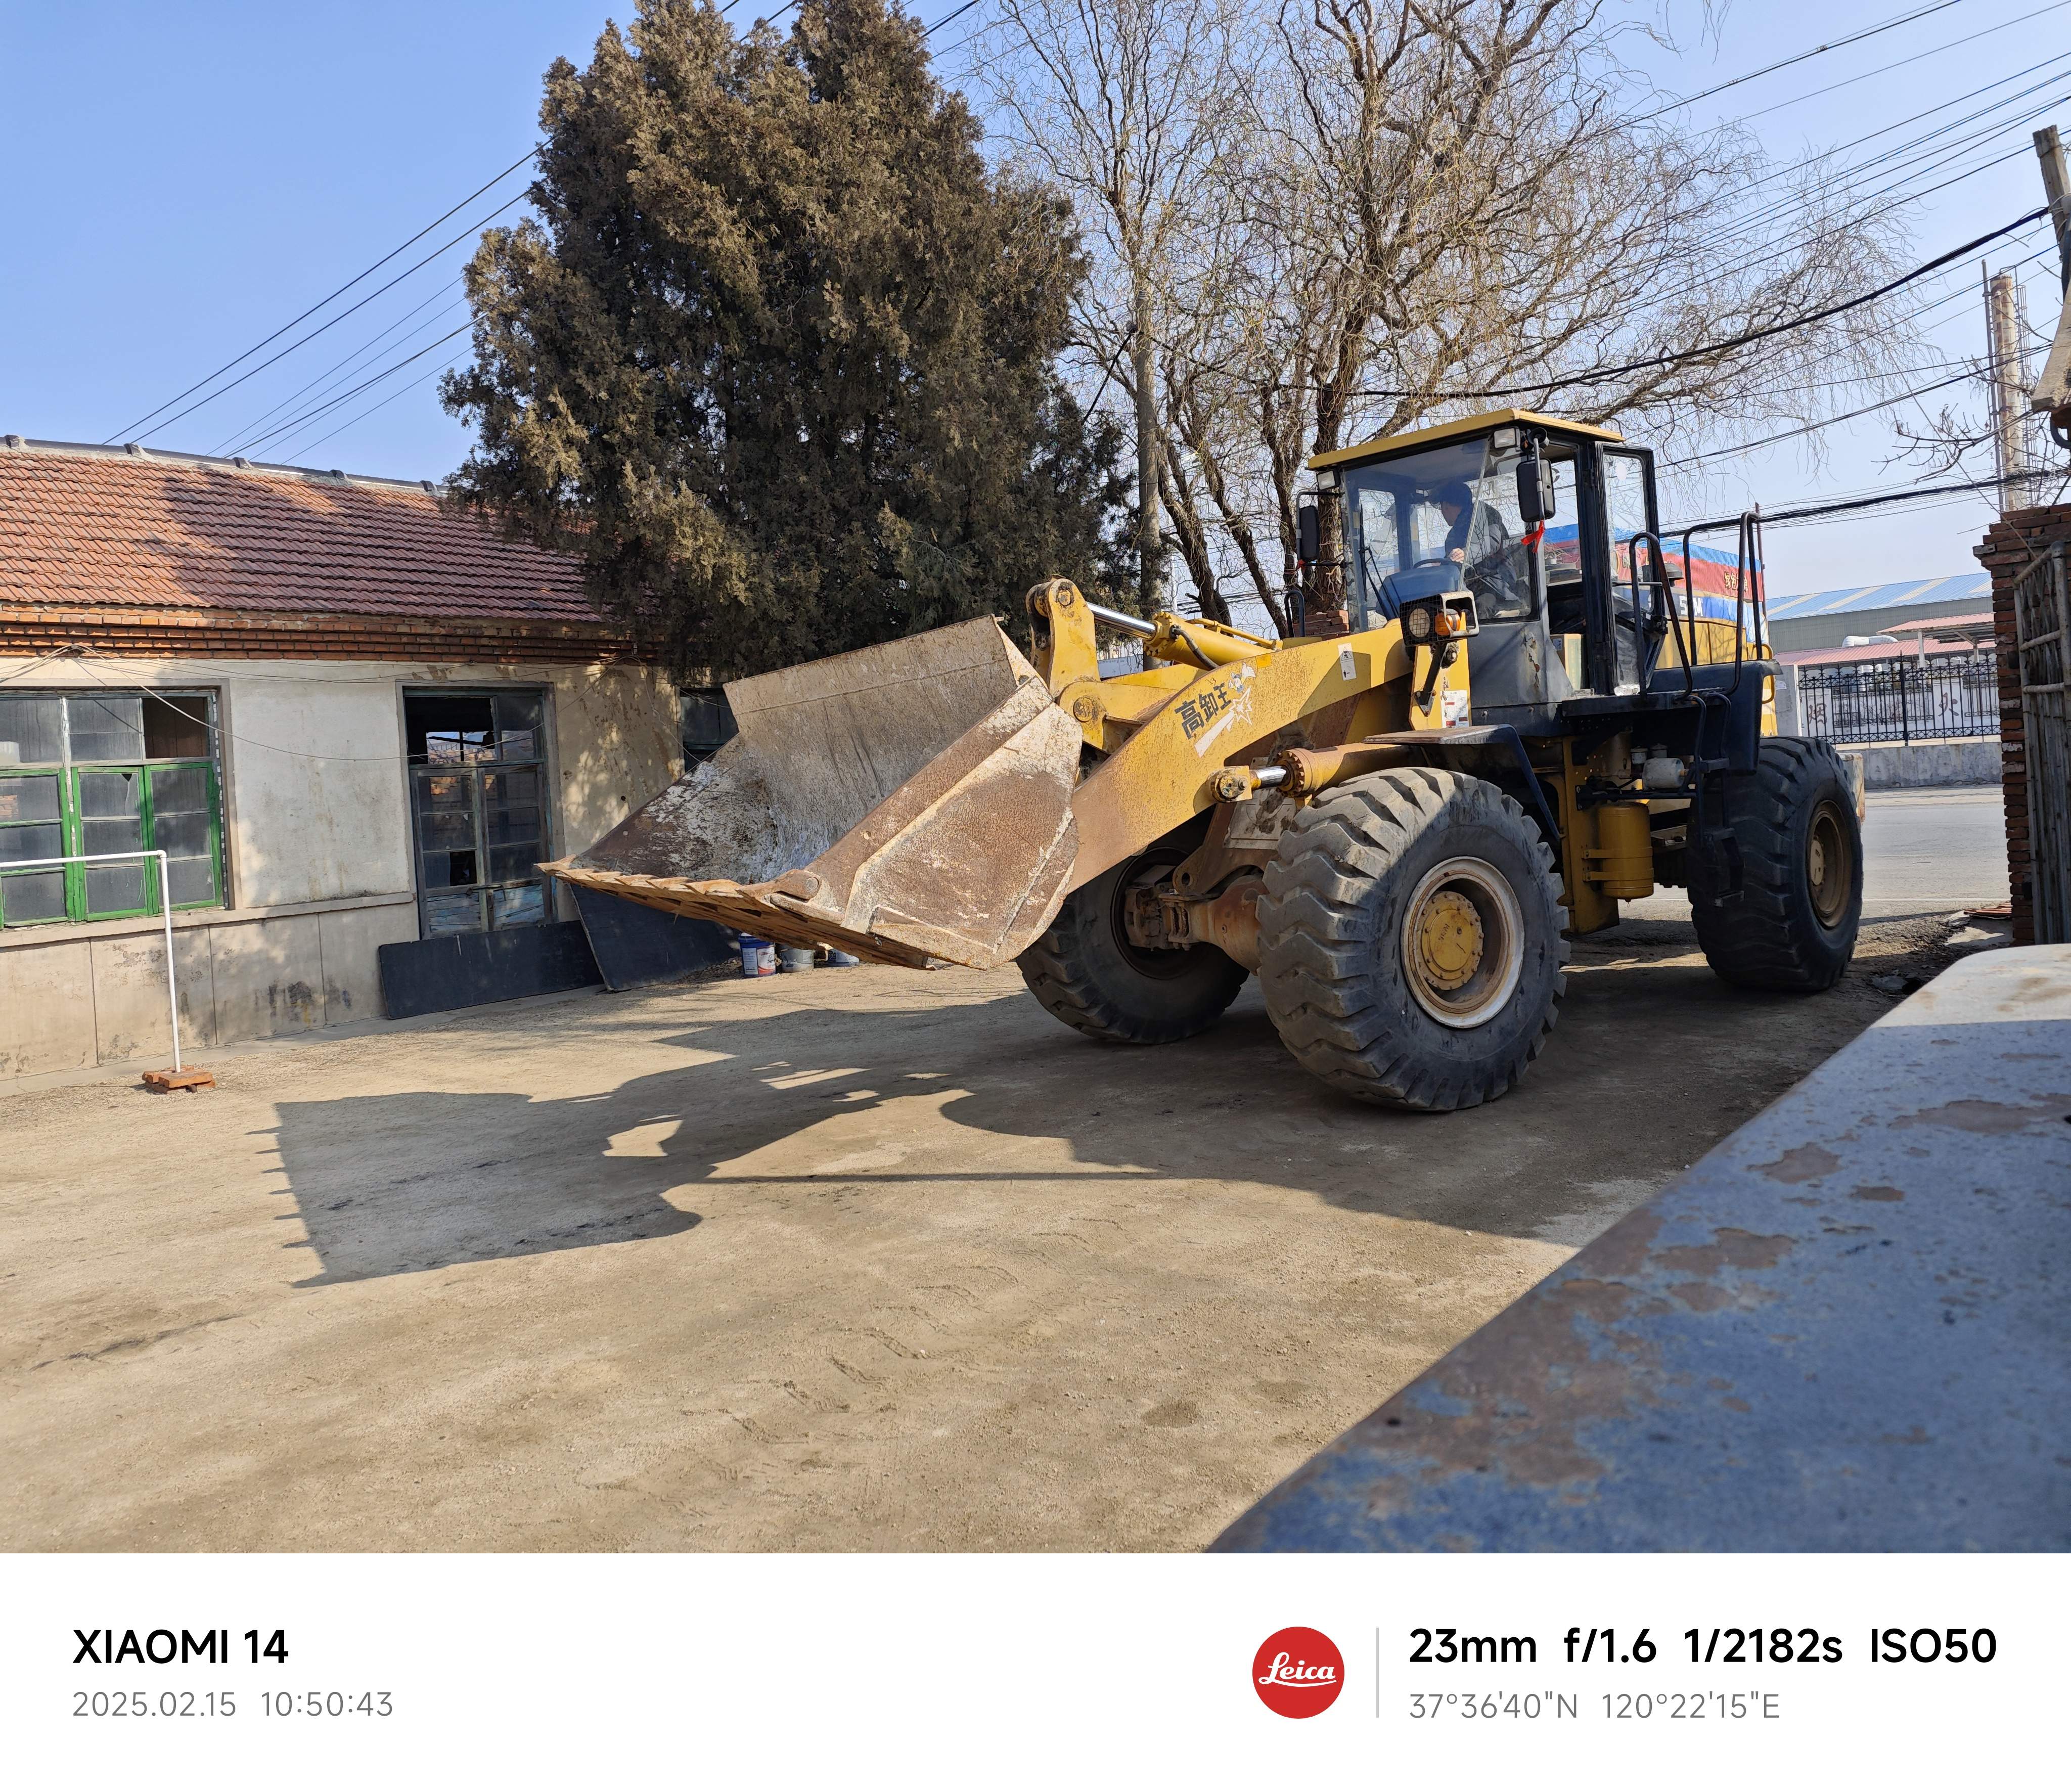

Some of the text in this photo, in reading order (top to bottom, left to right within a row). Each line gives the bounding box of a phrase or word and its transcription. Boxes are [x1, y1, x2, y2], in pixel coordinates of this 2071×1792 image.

[1679, 596, 1703, 616] SM
[1174, 682, 1232, 740] 高卸王
